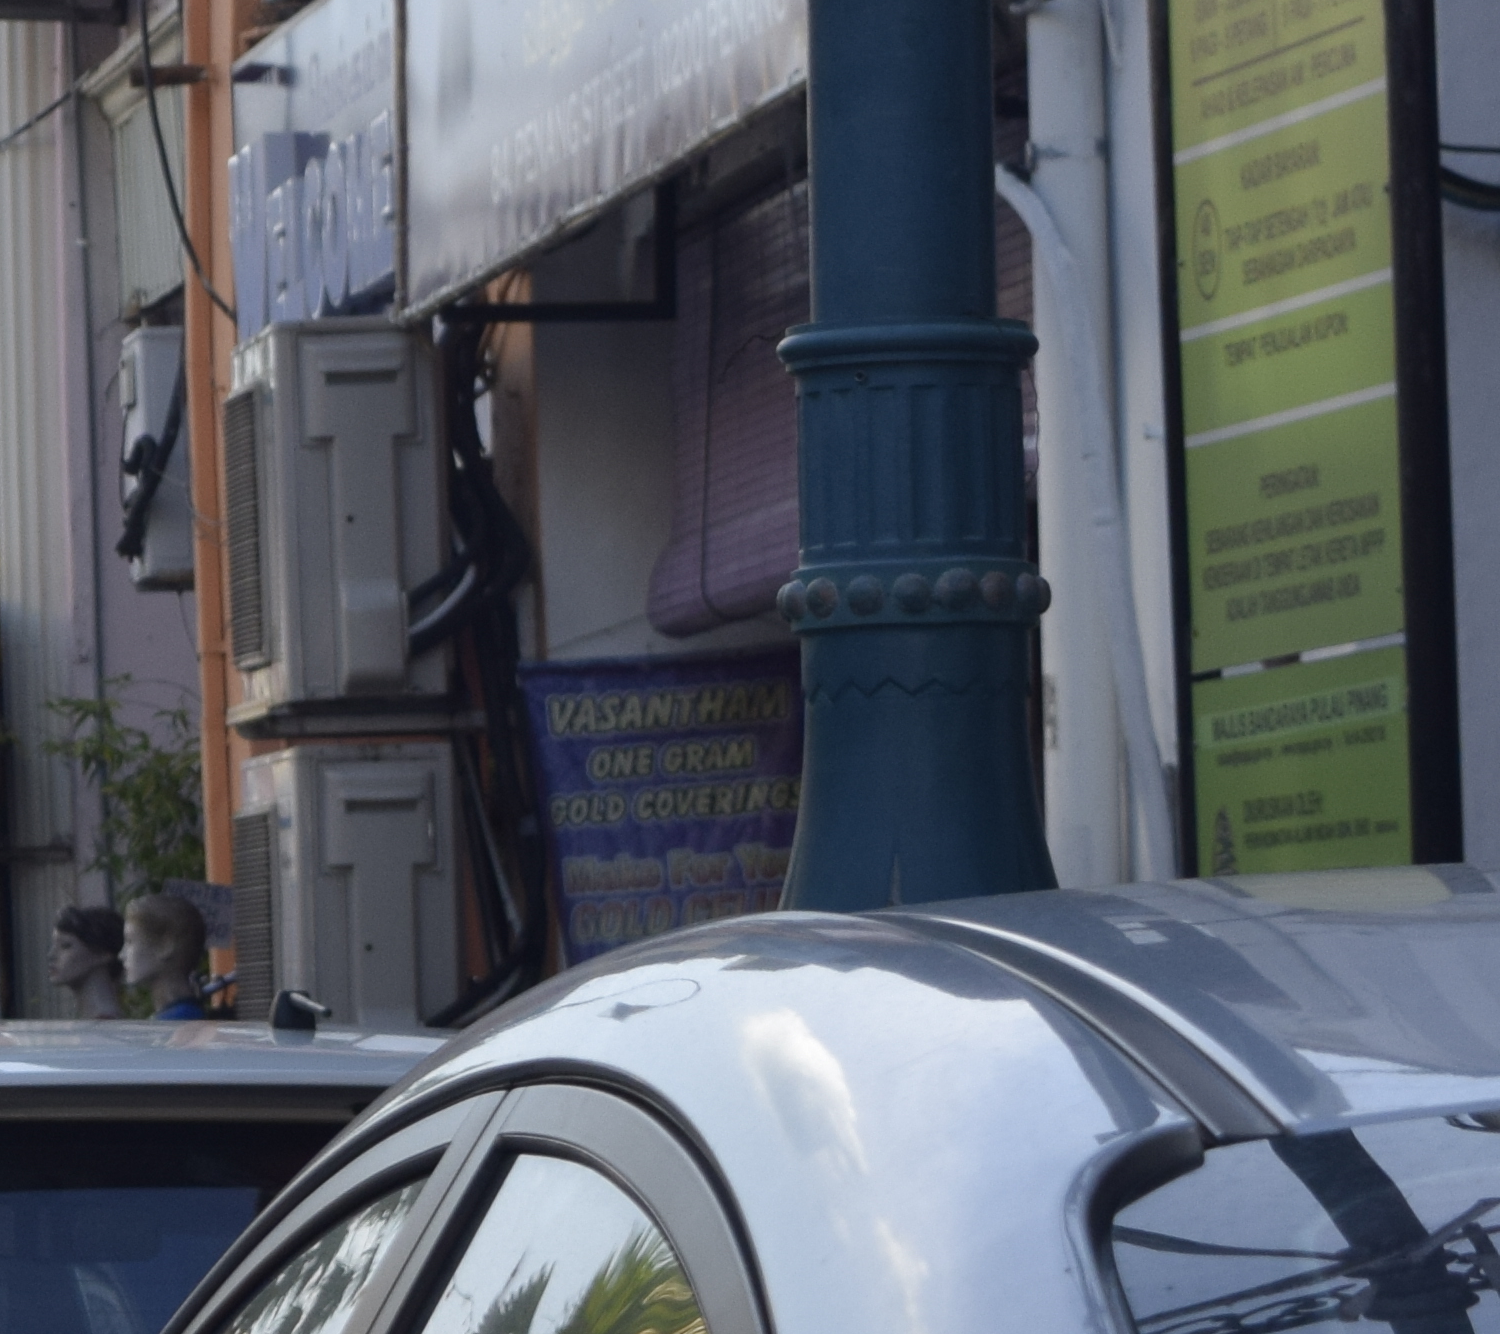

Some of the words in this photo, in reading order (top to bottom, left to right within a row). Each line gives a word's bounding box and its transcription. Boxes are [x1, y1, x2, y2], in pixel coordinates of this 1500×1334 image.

[550, 681, 787, 735] VASANTHAM
[590, 747, 653, 780] ONE
[661, 738, 755, 774] GRAM
[551, 794, 626, 825] GOLD
